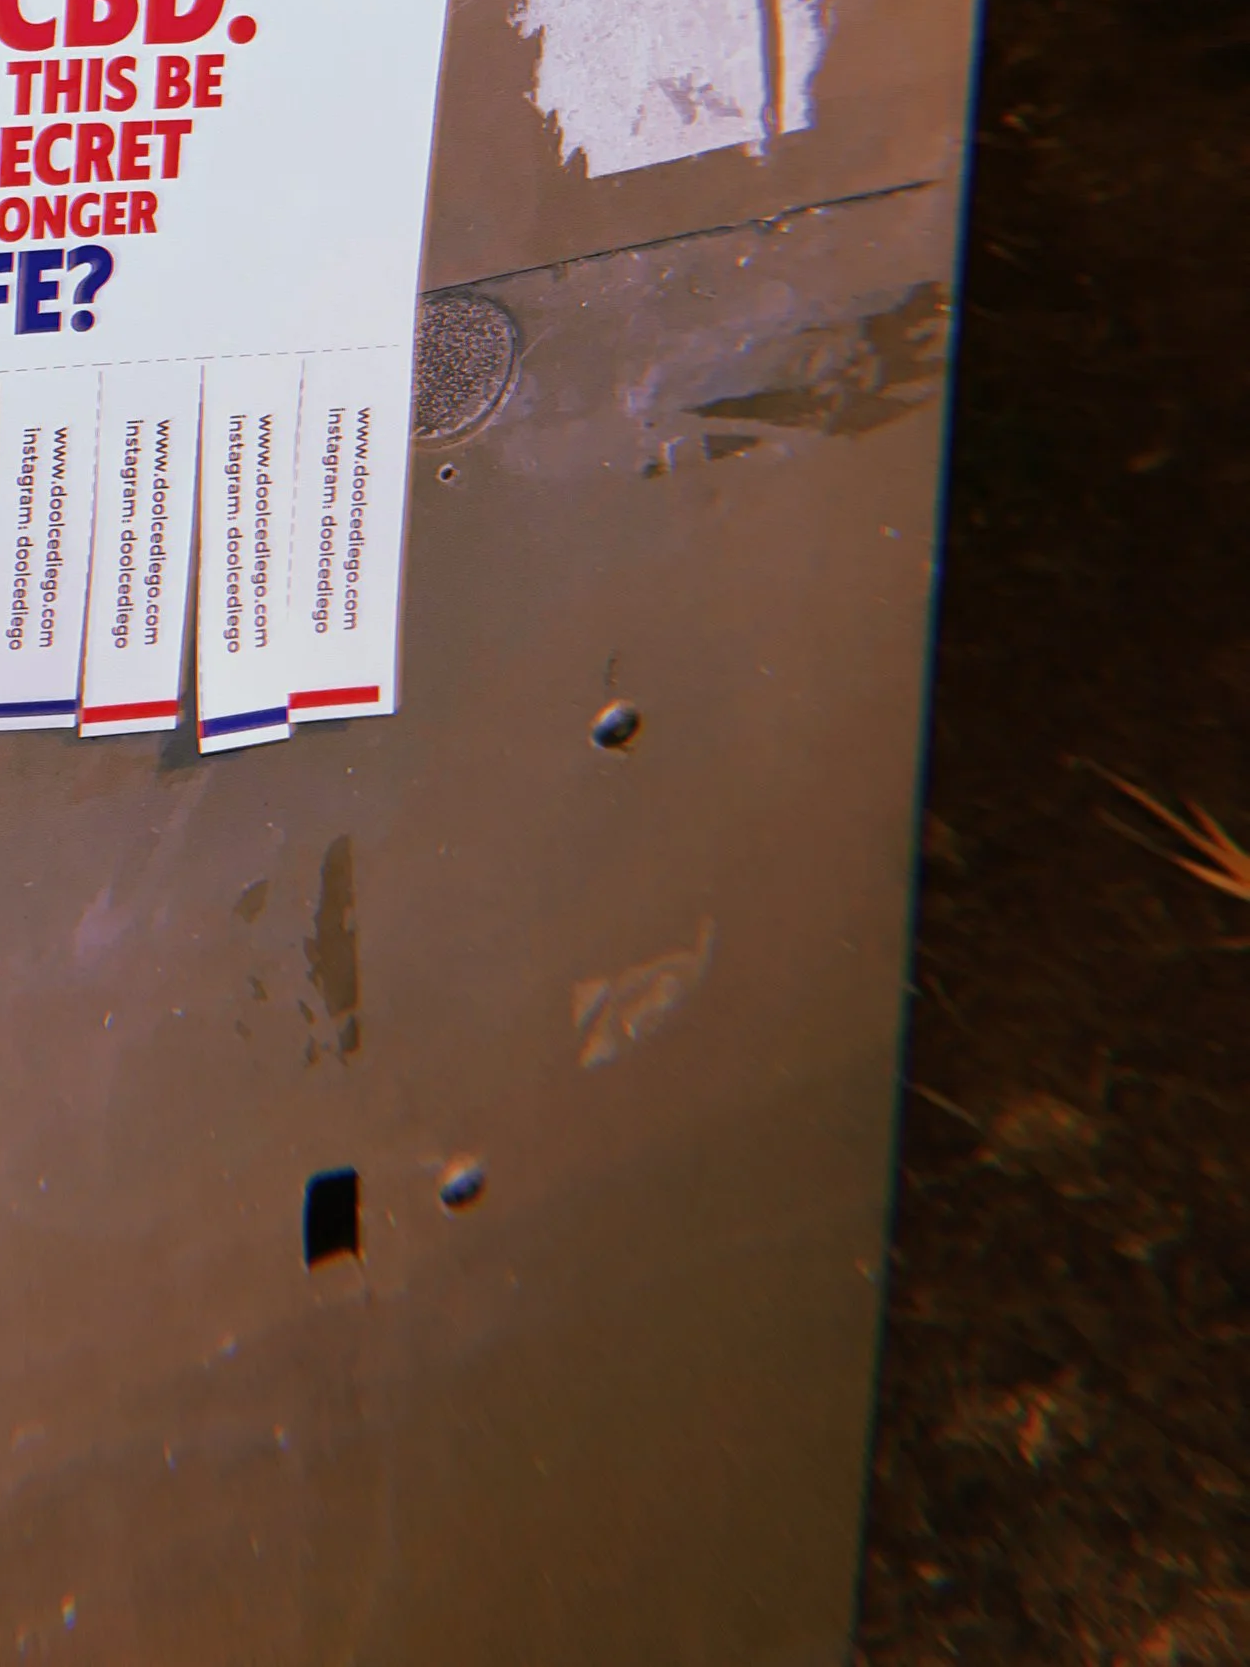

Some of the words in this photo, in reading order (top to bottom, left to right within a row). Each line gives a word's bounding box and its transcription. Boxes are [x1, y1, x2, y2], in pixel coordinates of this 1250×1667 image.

[7, 56, 137, 115] THIS
[156, 54, 224, 109] BE
[17, 428, 41, 530] instagram:
[121, 420, 144, 523] instagram:
[225, 415, 246, 520] instagram:
[322, 408, 345, 508] instagram:
[40, 427, 67, 647] www.doolcediego.com
[145, 420, 170, 645] www.doolcediego.com
[251, 414, 272, 647] www.doolcediego.com
[313, 516, 337, 633] doolcediego
[343, 408, 370, 630] www.doolcediego.com
[7, 536, 34, 650] doolcediego
[112, 530, 137, 648] doolcediego
[224, 527, 243, 653] doolcediego
